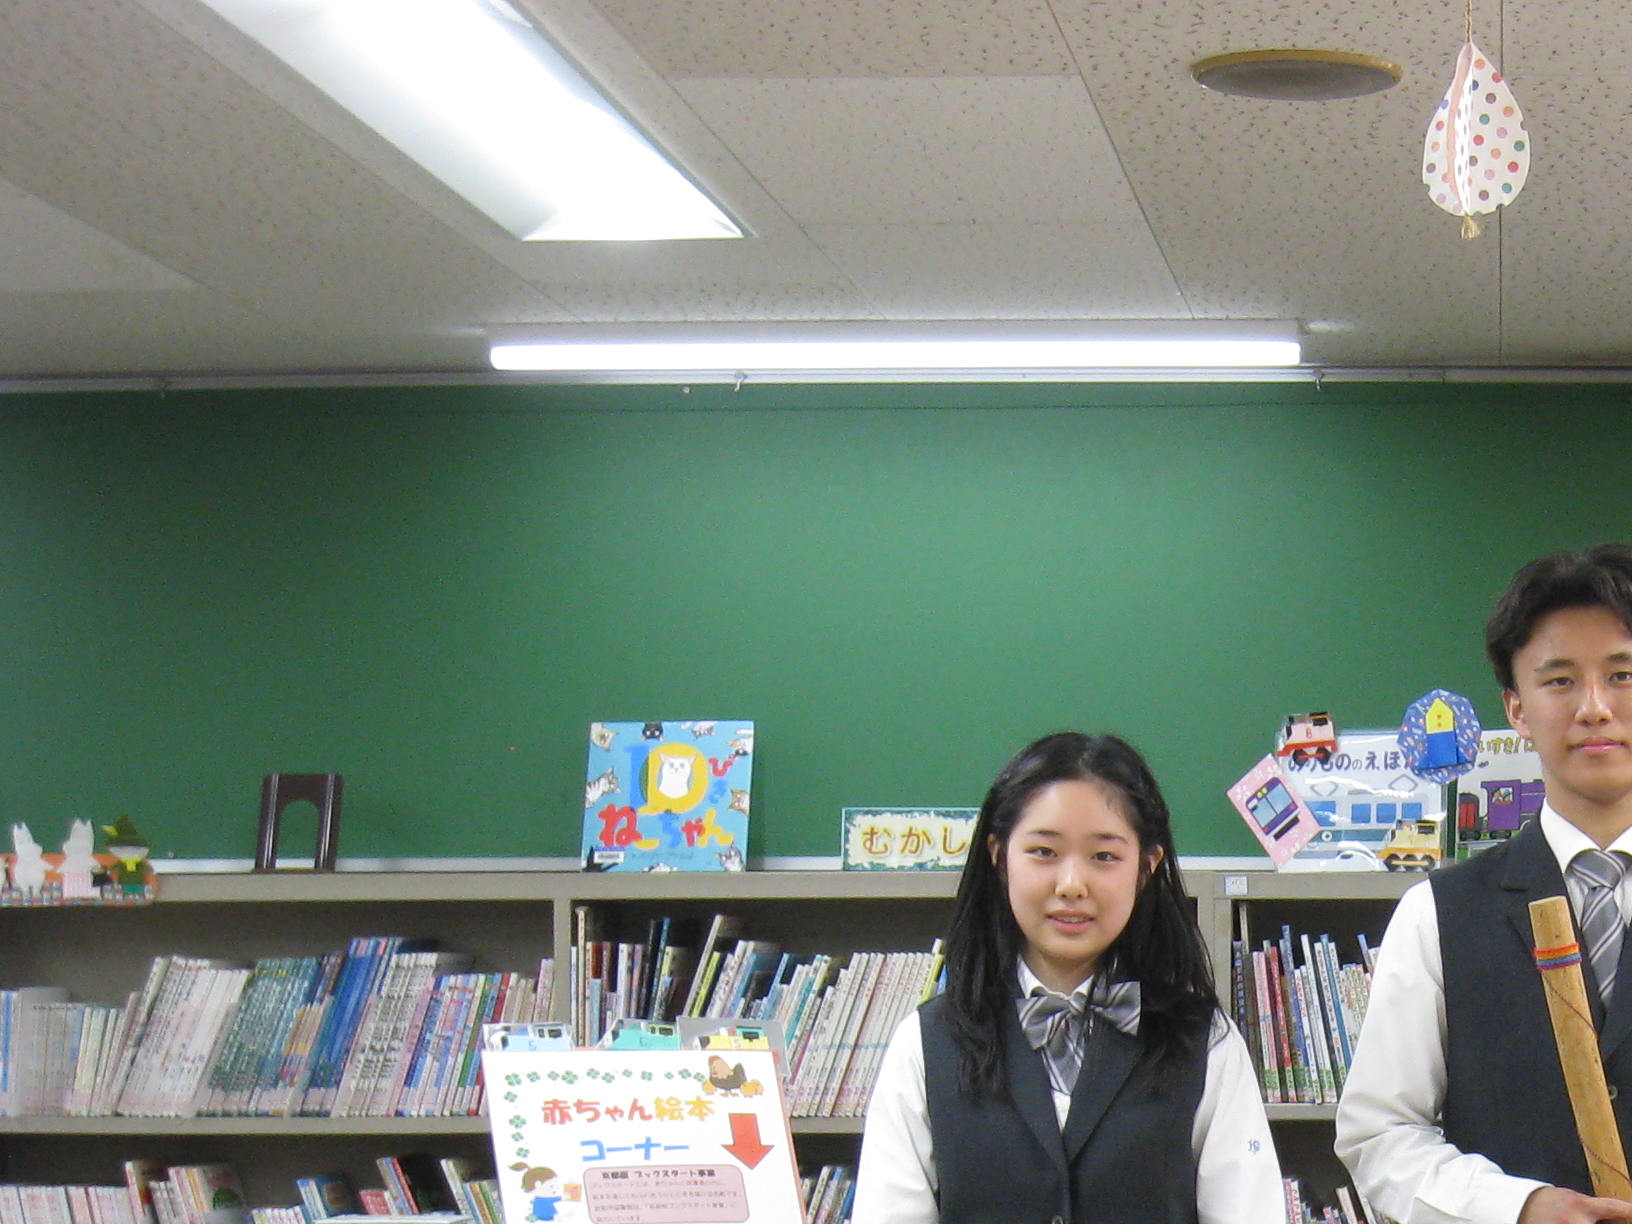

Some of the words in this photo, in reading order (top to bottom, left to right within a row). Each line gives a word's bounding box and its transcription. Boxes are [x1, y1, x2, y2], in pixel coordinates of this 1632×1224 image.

[541, 1095, 716, 1126] 赤ちゃん絵本
[580, 1136, 690, 1162] コーナー
